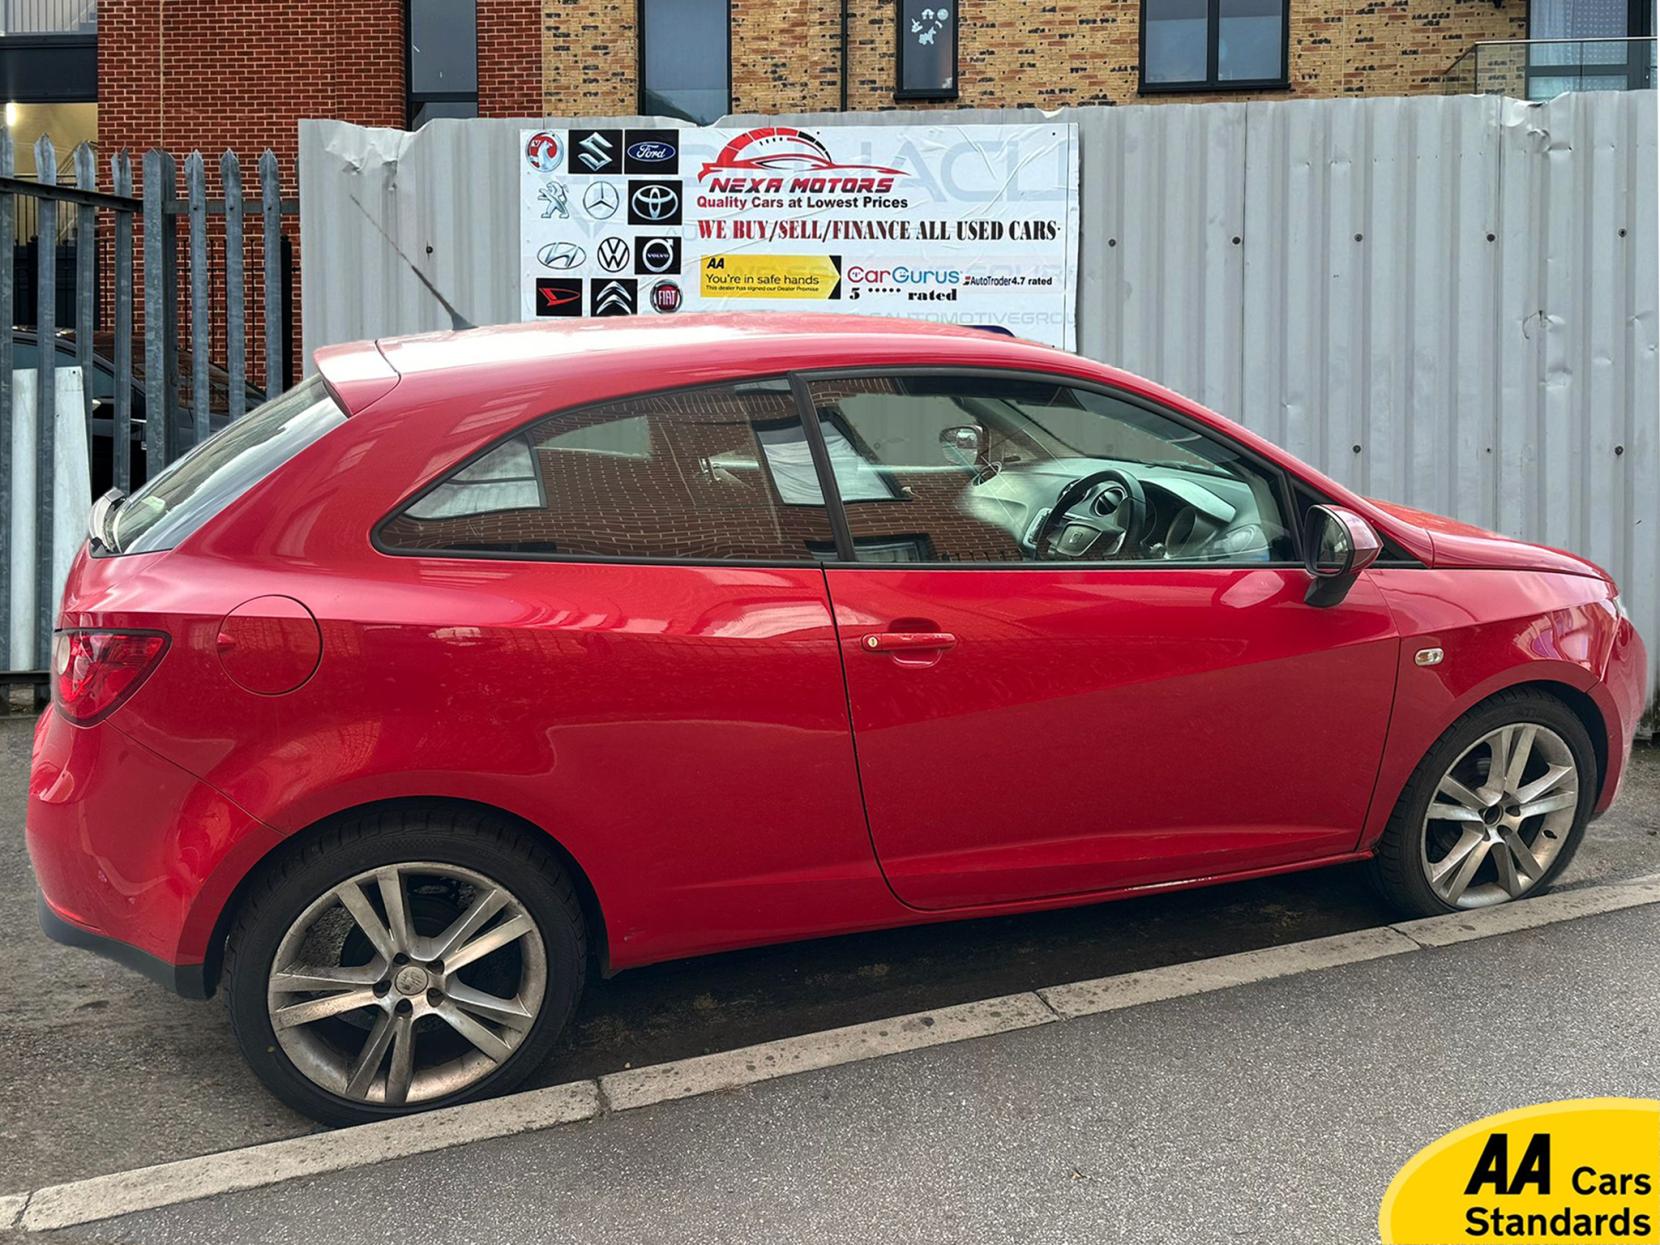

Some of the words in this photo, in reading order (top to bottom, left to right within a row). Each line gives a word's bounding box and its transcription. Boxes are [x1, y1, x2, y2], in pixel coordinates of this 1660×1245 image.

[636, 144, 666, 159] Ford
[708, 177, 784, 194] NEXA
[789, 177, 895, 194] MOTORS
[696, 195, 746, 210] Quality
[751, 196, 784, 208] Cars
[788, 196, 803, 208] at
[807, 196, 859, 208] Lowest
[863, 196, 908, 208] Prices
[697, 219, 727, 240] WE
[916, 220, 951, 241] ALL
[956, 220, 1004, 241] USED
[706, 257, 725, 269] AA
[706, 273, 741, 284] You're
[744, 273, 754, 284] in
[757, 273, 781, 285] safe
[784, 274, 820, 286] hands
[847, 265, 960, 285] CarGurus
[1028, 276, 1053, 286] rated
[658, 289, 677, 306] FIAT
[849, 287, 861, 301] 5
[908, 288, 958, 301] rated
